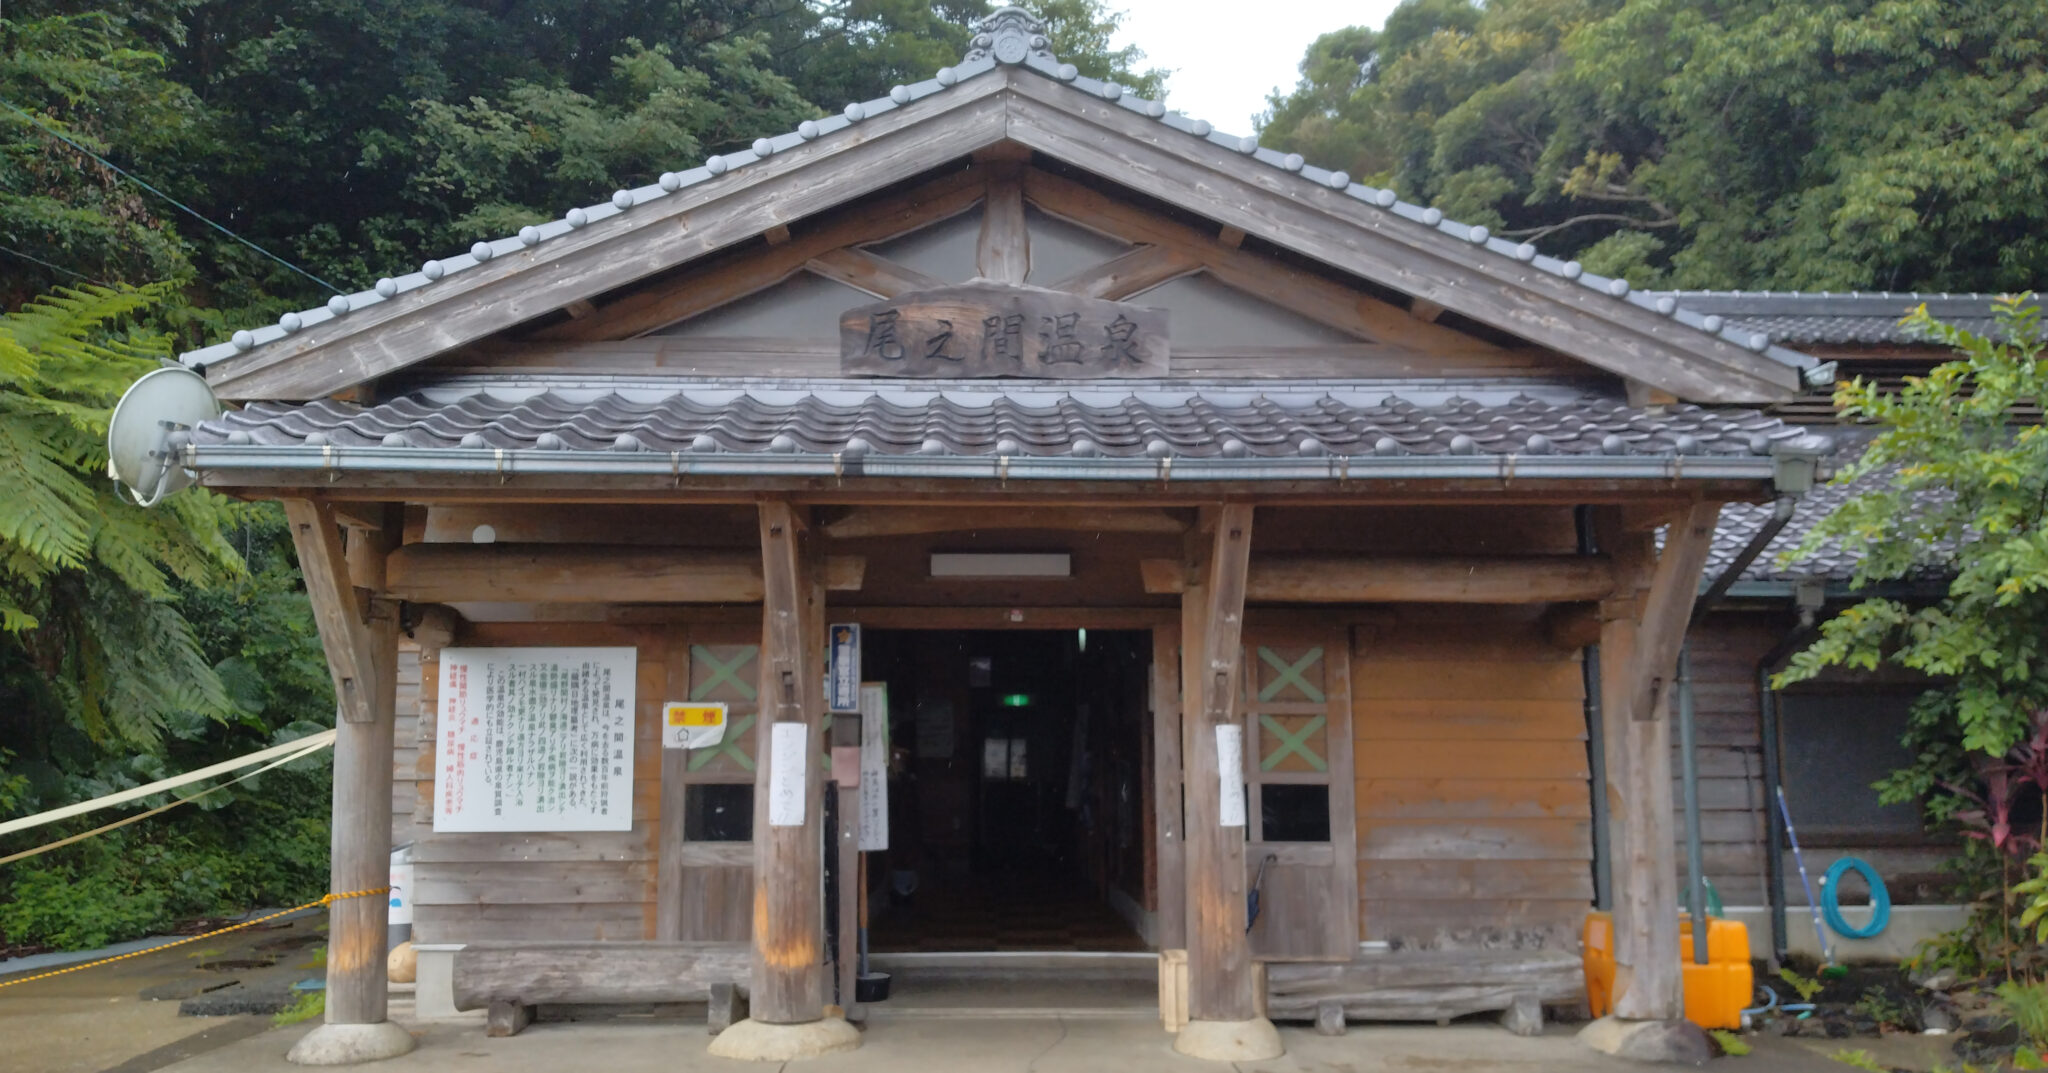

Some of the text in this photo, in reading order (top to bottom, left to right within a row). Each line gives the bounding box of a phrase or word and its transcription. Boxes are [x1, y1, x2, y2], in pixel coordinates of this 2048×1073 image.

[864, 309, 1144, 366] 尾之間温泉
[613, 699, 624, 776] 尾之間温泉
